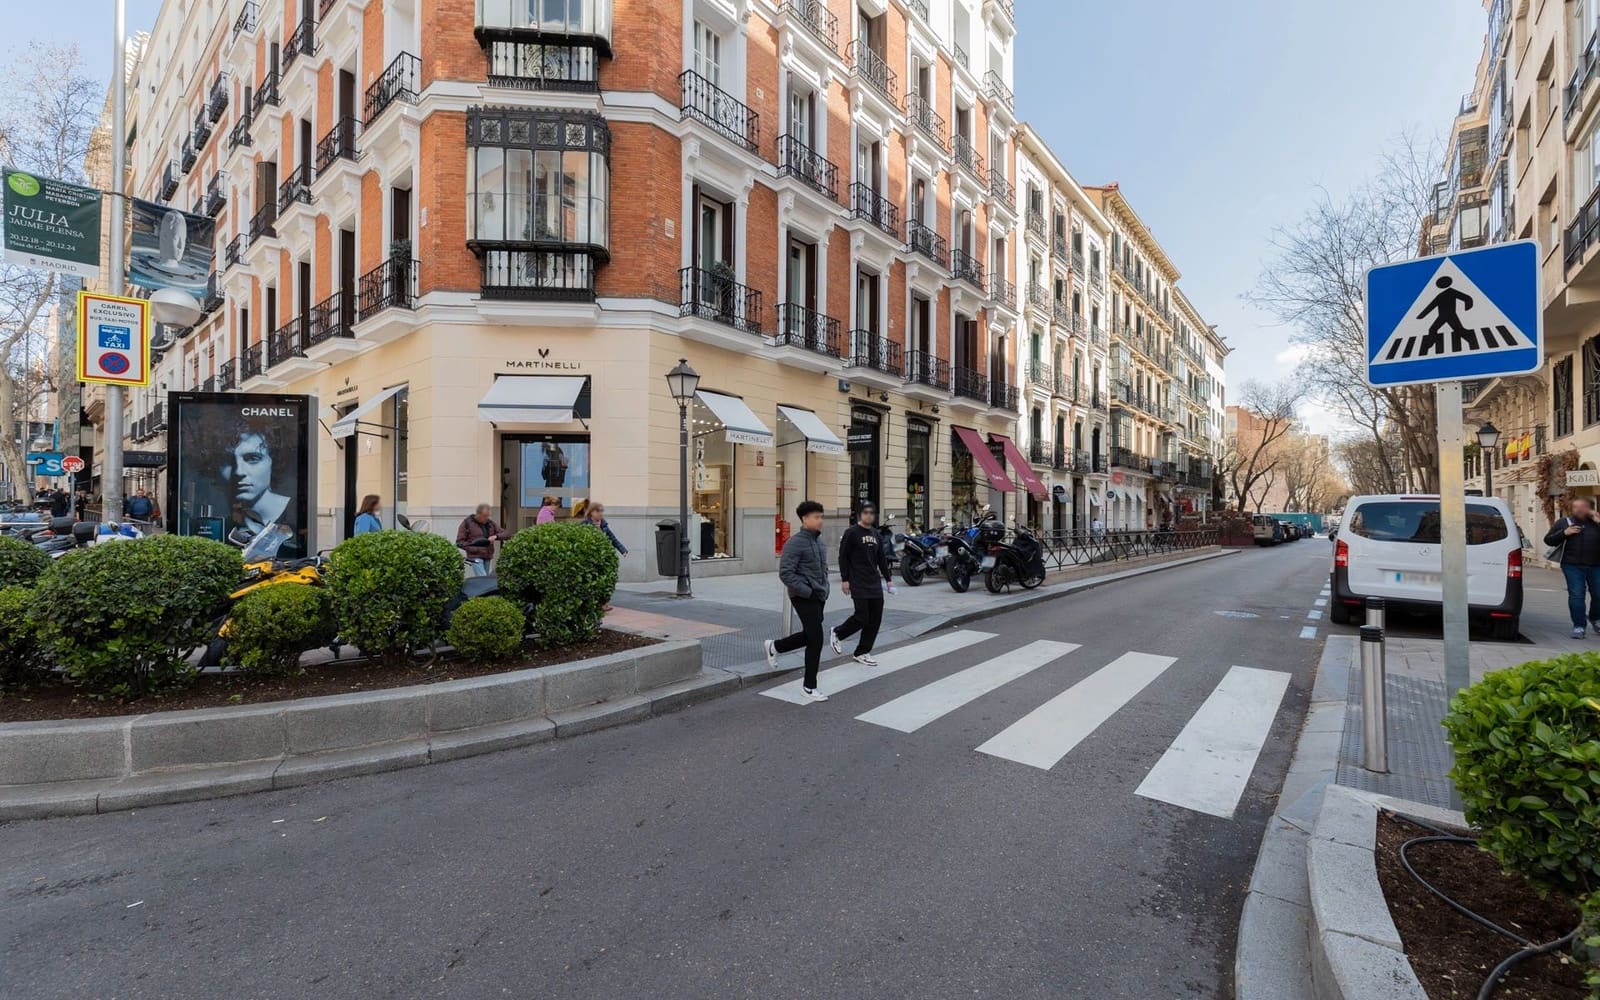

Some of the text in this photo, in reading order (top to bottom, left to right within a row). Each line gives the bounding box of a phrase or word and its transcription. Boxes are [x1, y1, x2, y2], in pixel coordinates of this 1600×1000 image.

[9, 205, 69, 227] JULIA
[9, 218, 85, 239] JAUME PLENSA
[46, 240, 76, 251] 20.12.24
[41, 260, 77, 272] MADRID
[101, 303, 128, 312] CARRIL
[93, 308, 136, 318] EXCLUSIVO
[104, 341, 125, 349] TAXI
[506, 361, 581, 369] MARTINELLI
[241, 407, 294, 417] CHANEL
